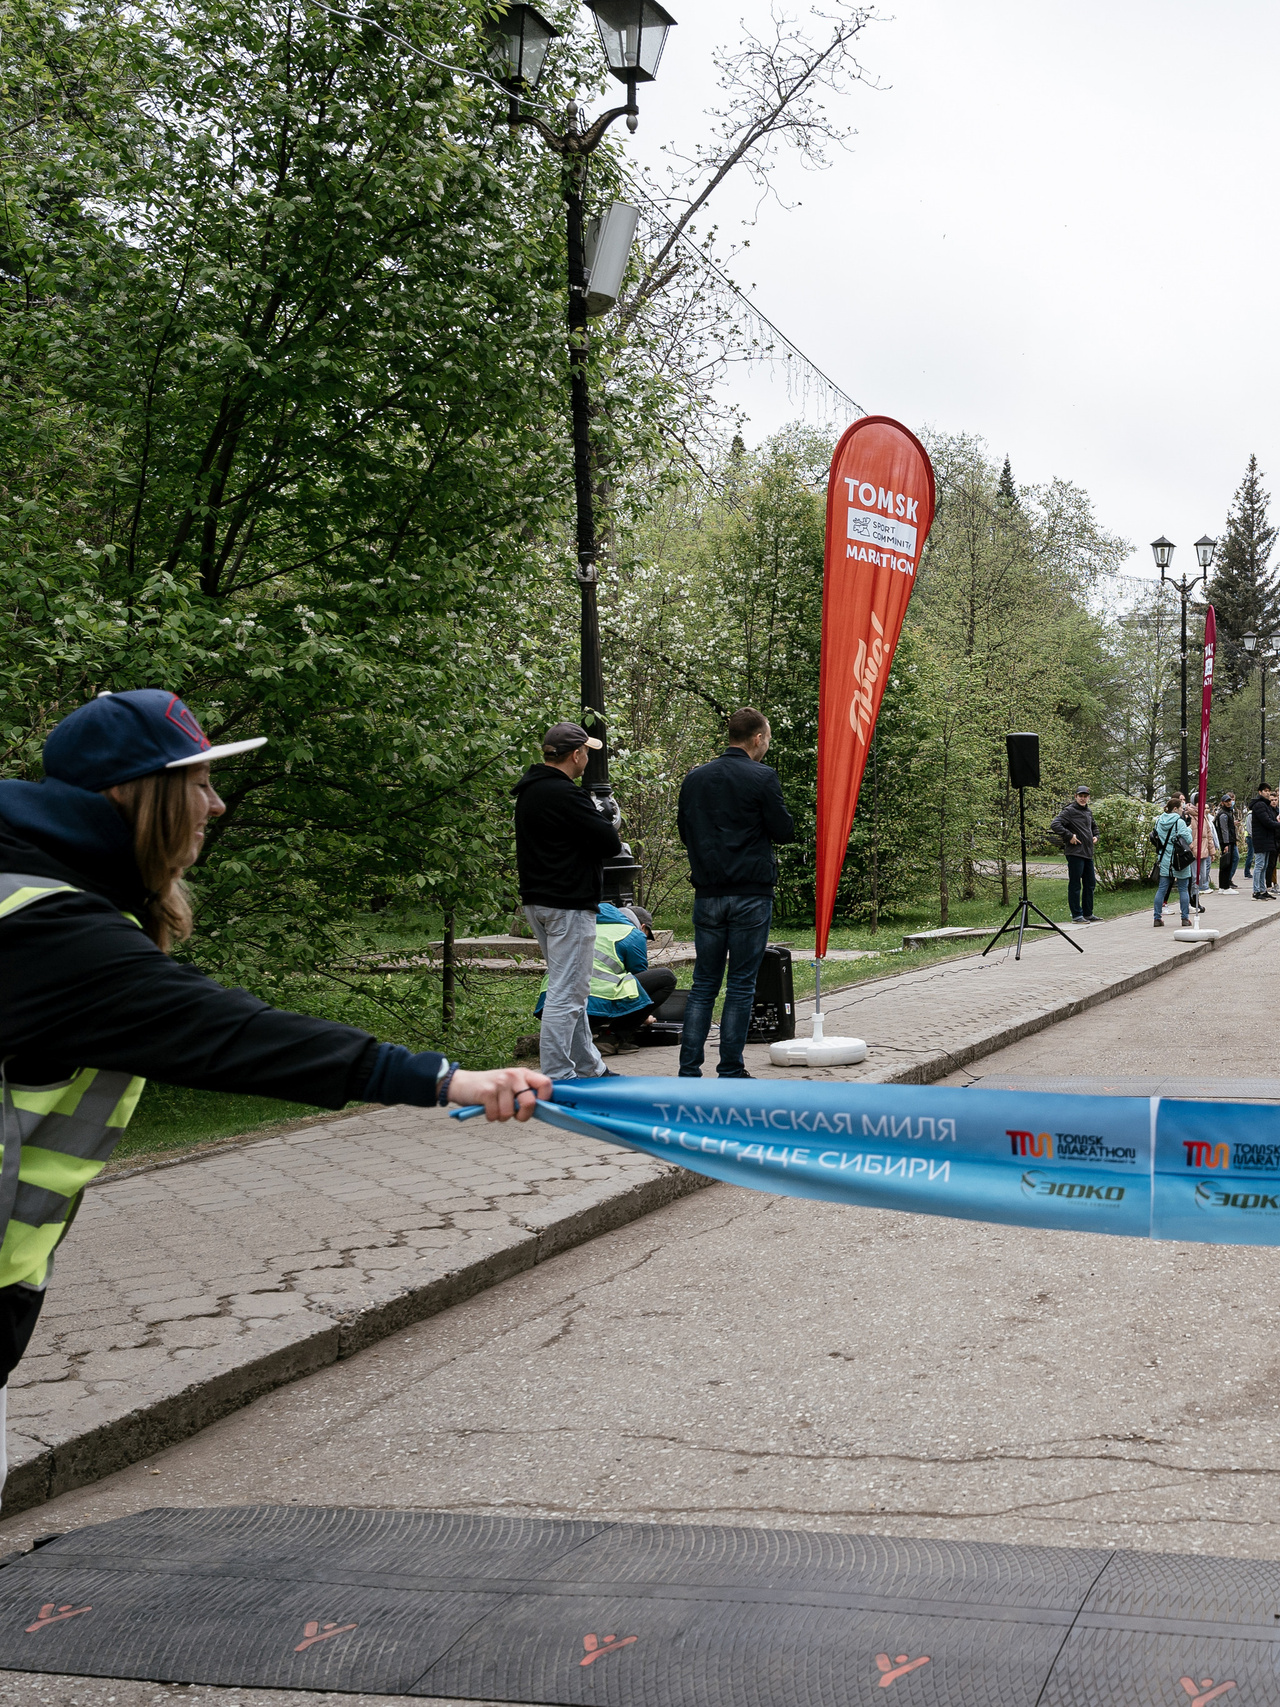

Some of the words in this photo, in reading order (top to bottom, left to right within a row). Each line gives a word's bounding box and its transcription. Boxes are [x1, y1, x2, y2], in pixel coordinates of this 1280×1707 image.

[844, 477, 919, 523] TOMSK
[872, 521, 895, 534] SPORT
[846, 544, 914, 576] MARATHON
[652, 1103, 853, 1135] ТАМАНСКАЯ
[861, 1113, 956, 1142] МИЛЯ
[1055, 1133, 1104, 1145] TOMSK
[1057, 1145, 1136, 1158] MARATHON
[678, 1131, 811, 1168] СЕРДЦЕ
[818, 1151, 951, 1183] СИБИРИ
[1036, 1181, 1125, 1201] ЭФКО
